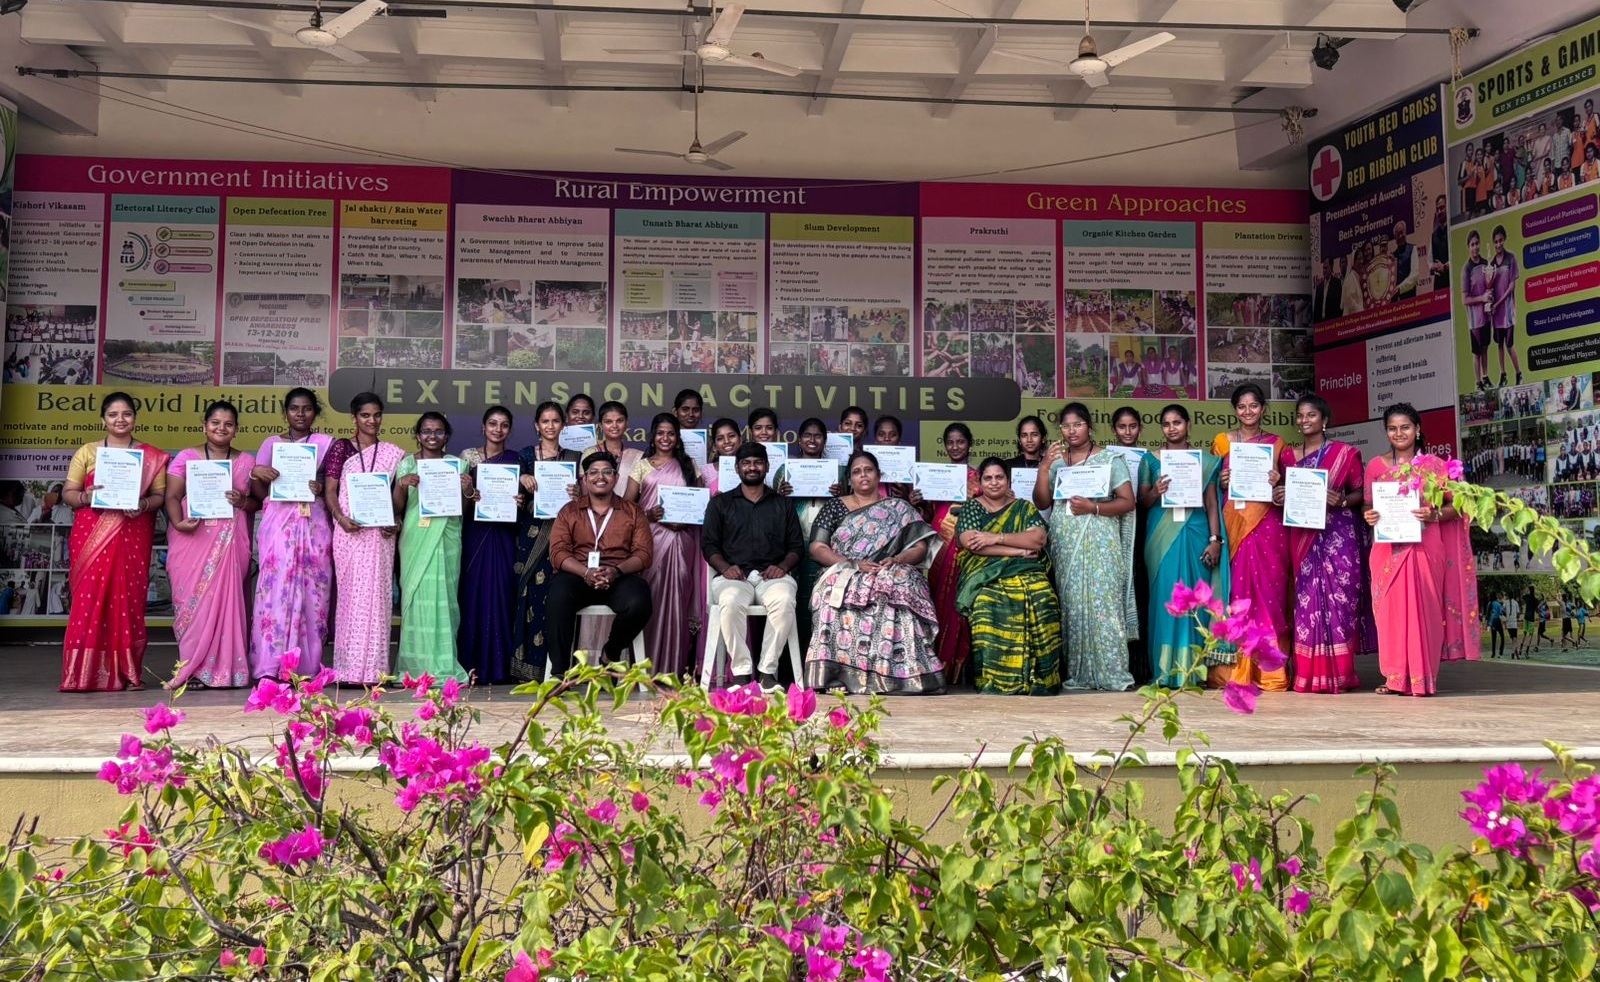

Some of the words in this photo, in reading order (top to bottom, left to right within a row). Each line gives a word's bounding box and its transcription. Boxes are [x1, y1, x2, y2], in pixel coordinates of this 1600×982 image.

[1478, 61, 1533, 103] SPORTS
[1541, 55, 1550, 77] &
[1495, 103, 1512, 115] RUN
[1516, 95, 1531, 107] FOR
[1535, 67, 1593, 97] EXCELLENCE
[1344, 121, 1376, 151] YOUTH
[1379, 111, 1398, 136] RED
[1402, 93, 1437, 125] CROSS
[1386, 136, 1393, 153] &
[1347, 166, 1366, 189] RED
[1369, 148, 1407, 180] RIBBON
[1410, 135, 1438, 163] CLUB
[87, 164, 251, 188] Government
[261, 169, 389, 192] Initiatives
[555, 179, 618, 200] Rural
[629, 182, 806, 206] Empowerment
[12, 201, 46, 210] Kishori
[48, 202, 86, 210] Vikasam
[115, 204, 154, 212] Electoral
[157, 205, 193, 214] Literacy
[195, 206, 216, 214] Club
[345, 204, 357, 212] Jal
[359, 204, 386, 213] shakti
[395, 206, 414, 214] Rain
[417, 207, 443, 215] Water
[1027, 192, 1098, 211] Green
[1107, 193, 1247, 216] Approaches
[1325, 198, 1369, 223] Presentation
[1370, 194, 1378, 206] of
[1378, 184, 1406, 203] Awards
[233, 207, 256, 216] Open
[258, 207, 306, 216] Defecation
[307, 209, 327, 217] Free
[1525, 217, 1547, 228] National
[1561, 204, 1594, 218] Participants
[371, 216, 418, 227] harvesting
[482, 215, 515, 223] Swachh
[517, 216, 546, 224] Bharat
[548, 216, 583, 226] Abhiyan
[642, 220, 673, 228] Unnath
[675, 220, 703, 228] Bharat
[704, 221, 738, 230] Abhiyan
[827, 224, 880, 233] Development
[970, 227, 1009, 235] Prakruthi
[1082, 230, 1113, 238] Organic
[1115, 230, 1146, 238] Kitchen
[1338, 230, 1353, 242] Best
[1354, 214, 1394, 237] Performers
[1234, 232, 1275, 240] Plantation
[1564, 232, 1591, 244] University
[489, 248, 531, 256] Management
[1544, 247, 1576, 260] Participants
[1543, 277, 1556, 285] Zone
[1570, 266, 1598, 277] University
[1546, 281, 1578, 294] Participants
[1547, 314, 1561, 324] Level
[1562, 308, 1595, 320] Participants
[247, 329, 299, 338] 13-12-2018
[1394, 339, 1403, 348] and
[1403, 335, 1424, 345] alleviate
[1425, 331, 1442, 340] human
[1376, 354, 1397, 364] suffering
[1576, 350, 1597, 359] Players
[1376, 367, 1393, 376] Protect
[1403, 362, 1412, 371] and
[1412, 359, 1428, 369] health
[1320, 371, 1362, 391] Principle
[1392, 376, 1410, 386] respect
[1410, 373, 1418, 381] for
[1418, 371, 1436, 379] human
[387, 379, 664, 407] EXTENSION
[699, 384, 967, 411] ACTIVITIES
[37, 392, 96, 412] Beat
[133, 392, 182, 413] ovid
[193, 393, 286, 413] Intiativ
[1194, 411, 1294, 429] Respsibi
[3, 423, 47, 431] motivate
[51, 423, 69, 431] and
[73, 423, 108, 431] mobiliz
[153, 424, 164, 432] to
[0, 436, 52, 445] munization
[54, 437, 68, 445] for
[988, 438, 1010, 446] plays
[979, 450, 1012, 459] through
